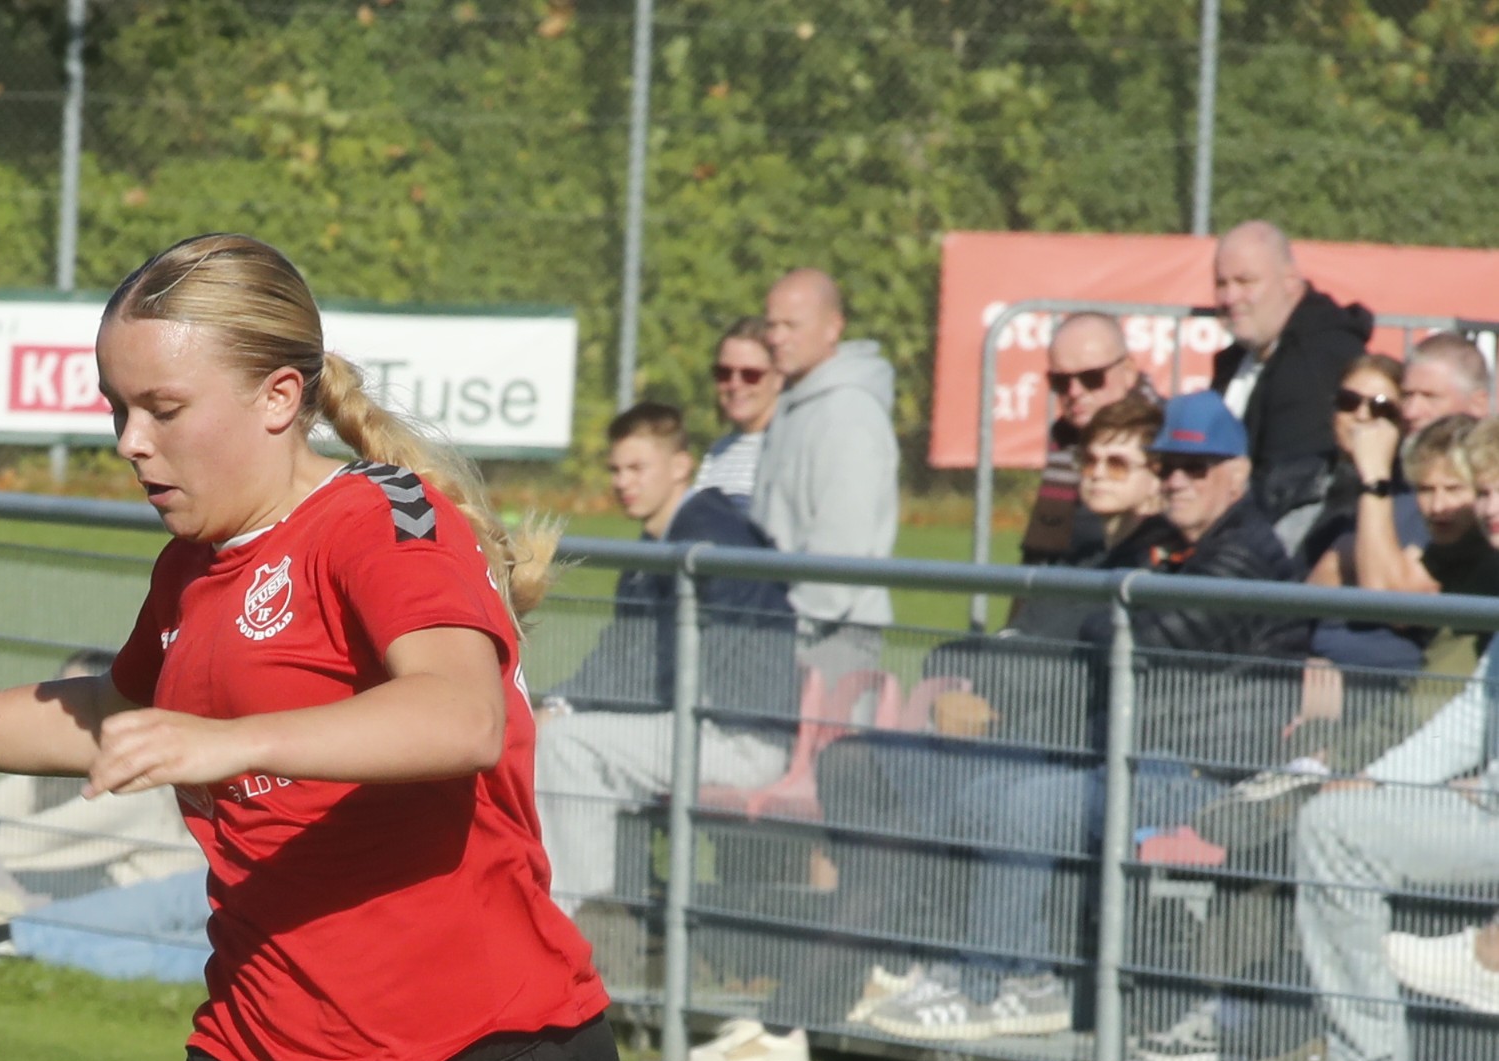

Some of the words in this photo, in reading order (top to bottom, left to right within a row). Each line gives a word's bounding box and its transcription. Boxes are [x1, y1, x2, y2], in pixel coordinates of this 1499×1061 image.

[365, 358, 538, 427] Tuse
[247, 569, 290, 613] TUSE
[256, 606, 273, 622] IF
